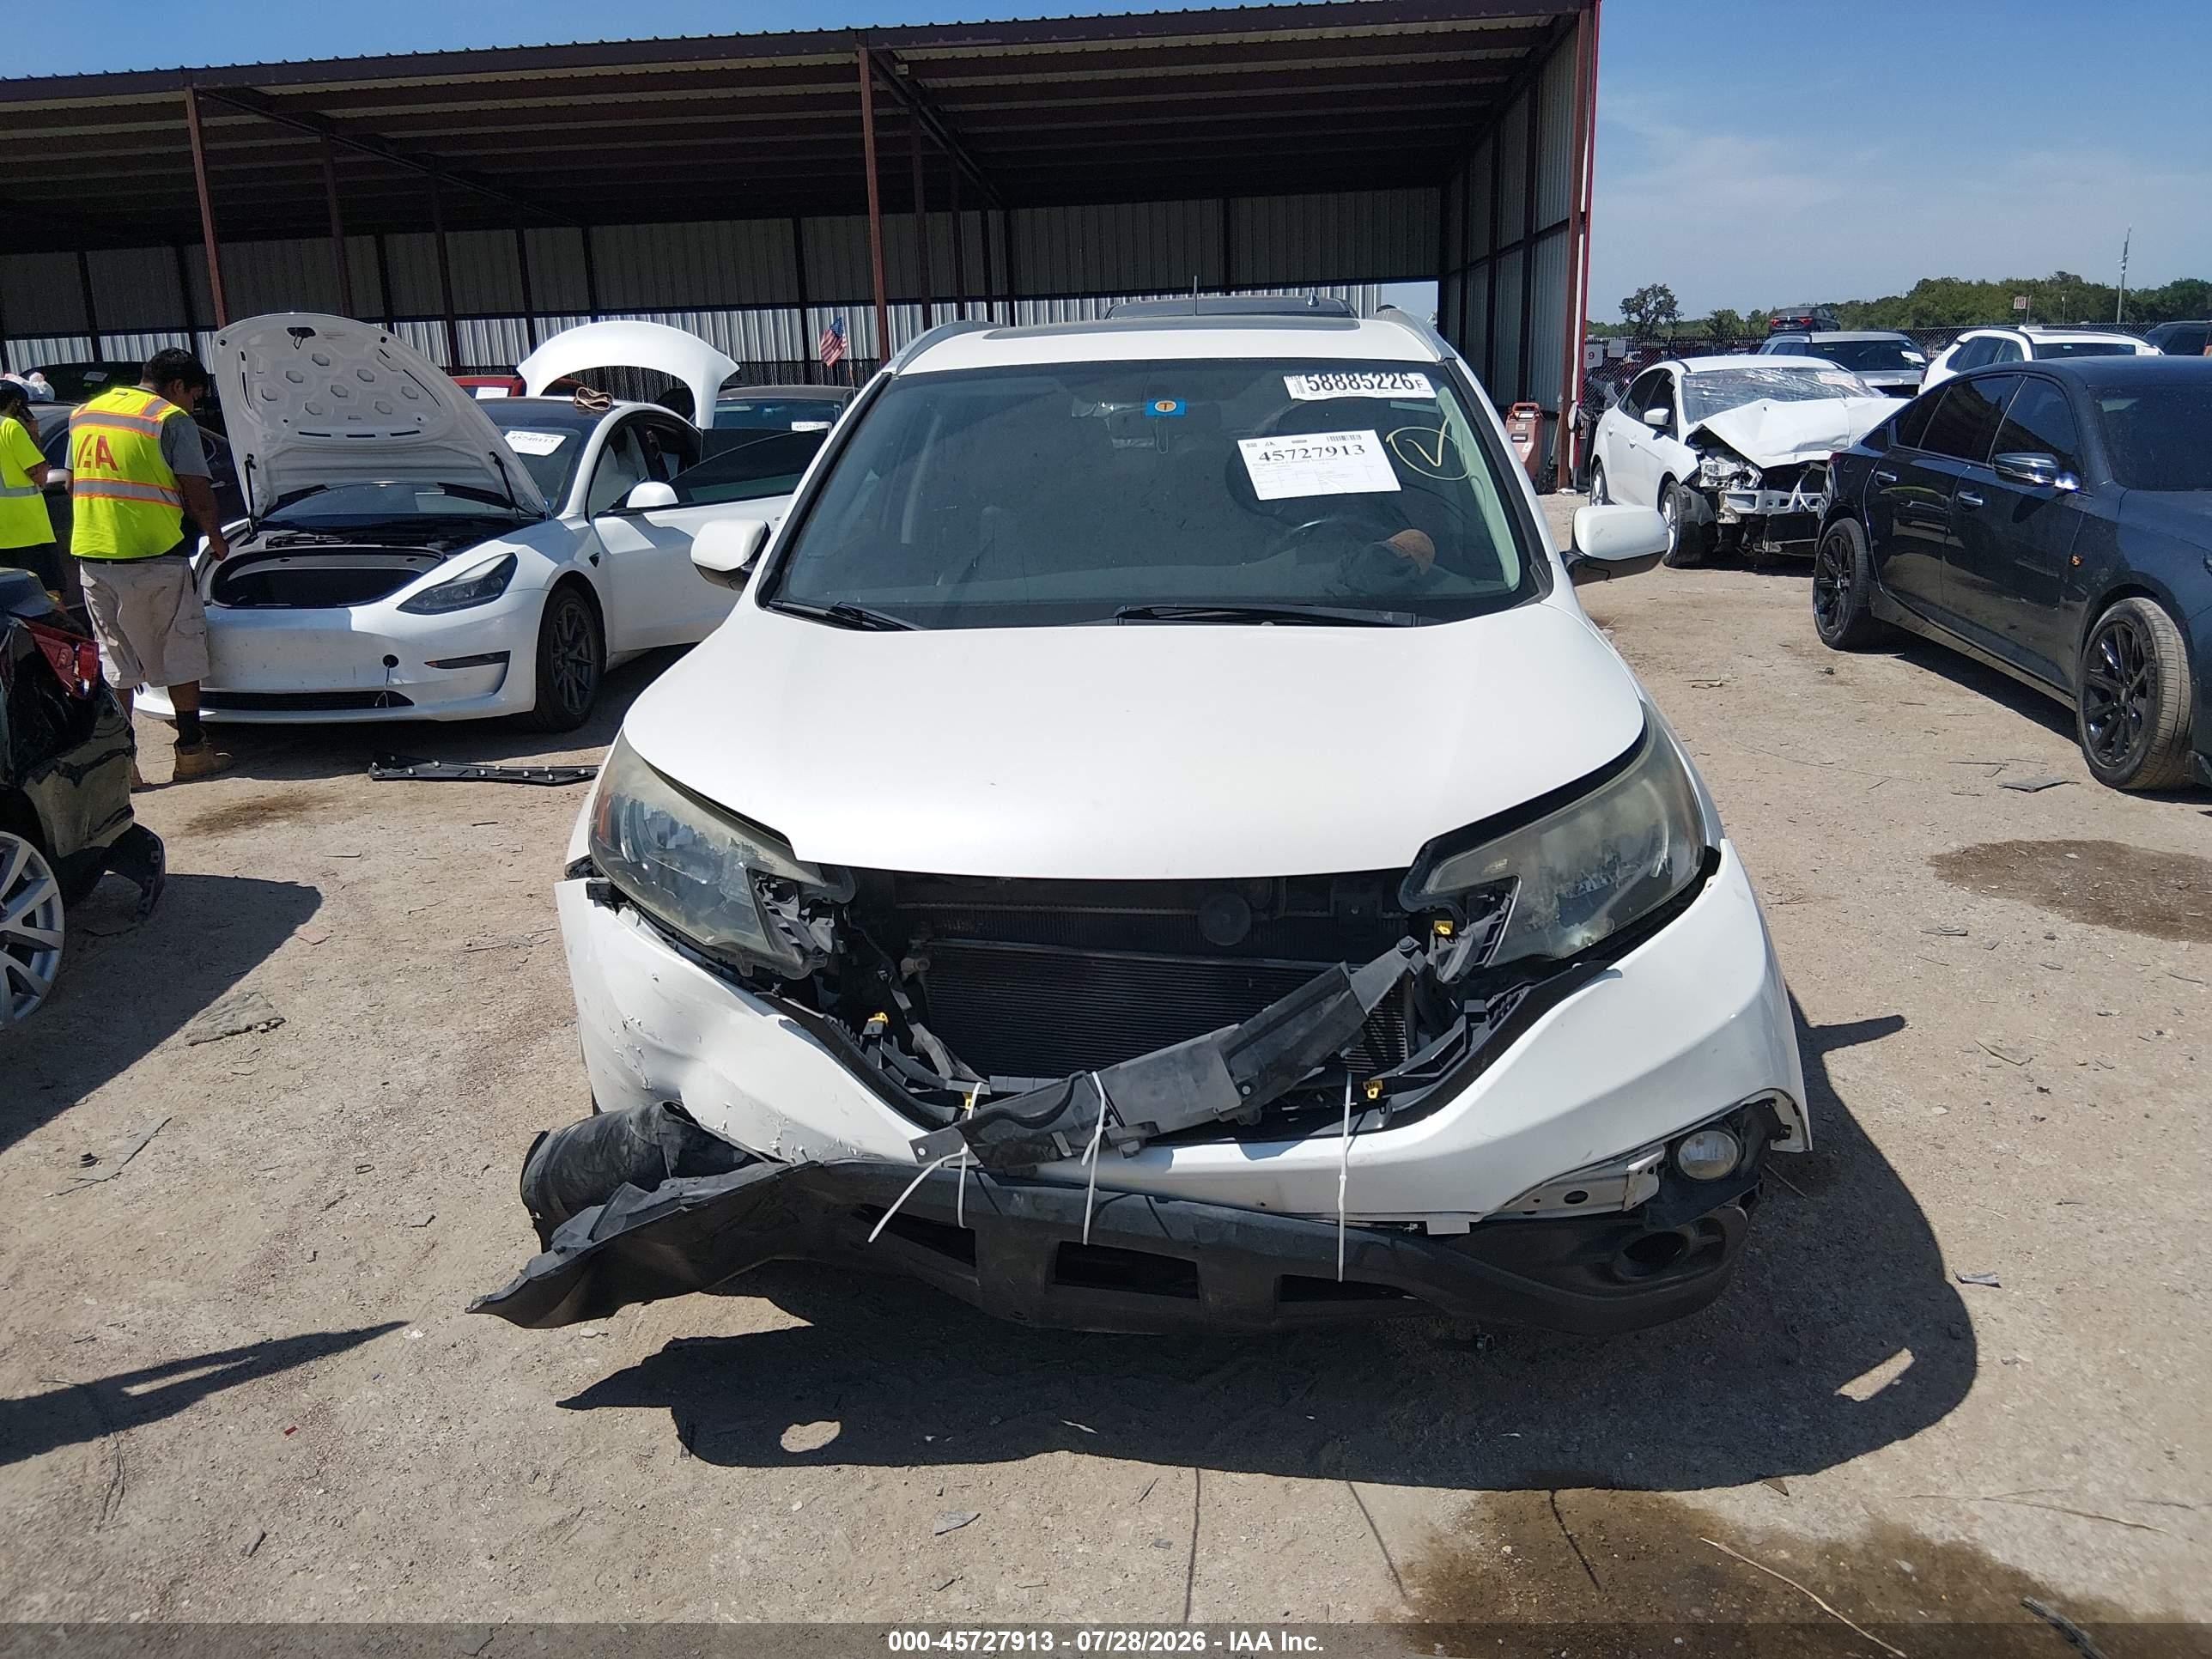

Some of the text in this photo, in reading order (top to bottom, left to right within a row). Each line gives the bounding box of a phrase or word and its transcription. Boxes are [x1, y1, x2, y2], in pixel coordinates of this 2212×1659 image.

[1588, 351, 1595, 360] 9
[1304, 373, 1414, 392] 58885226
[1259, 444, 1366, 461] 45727913
